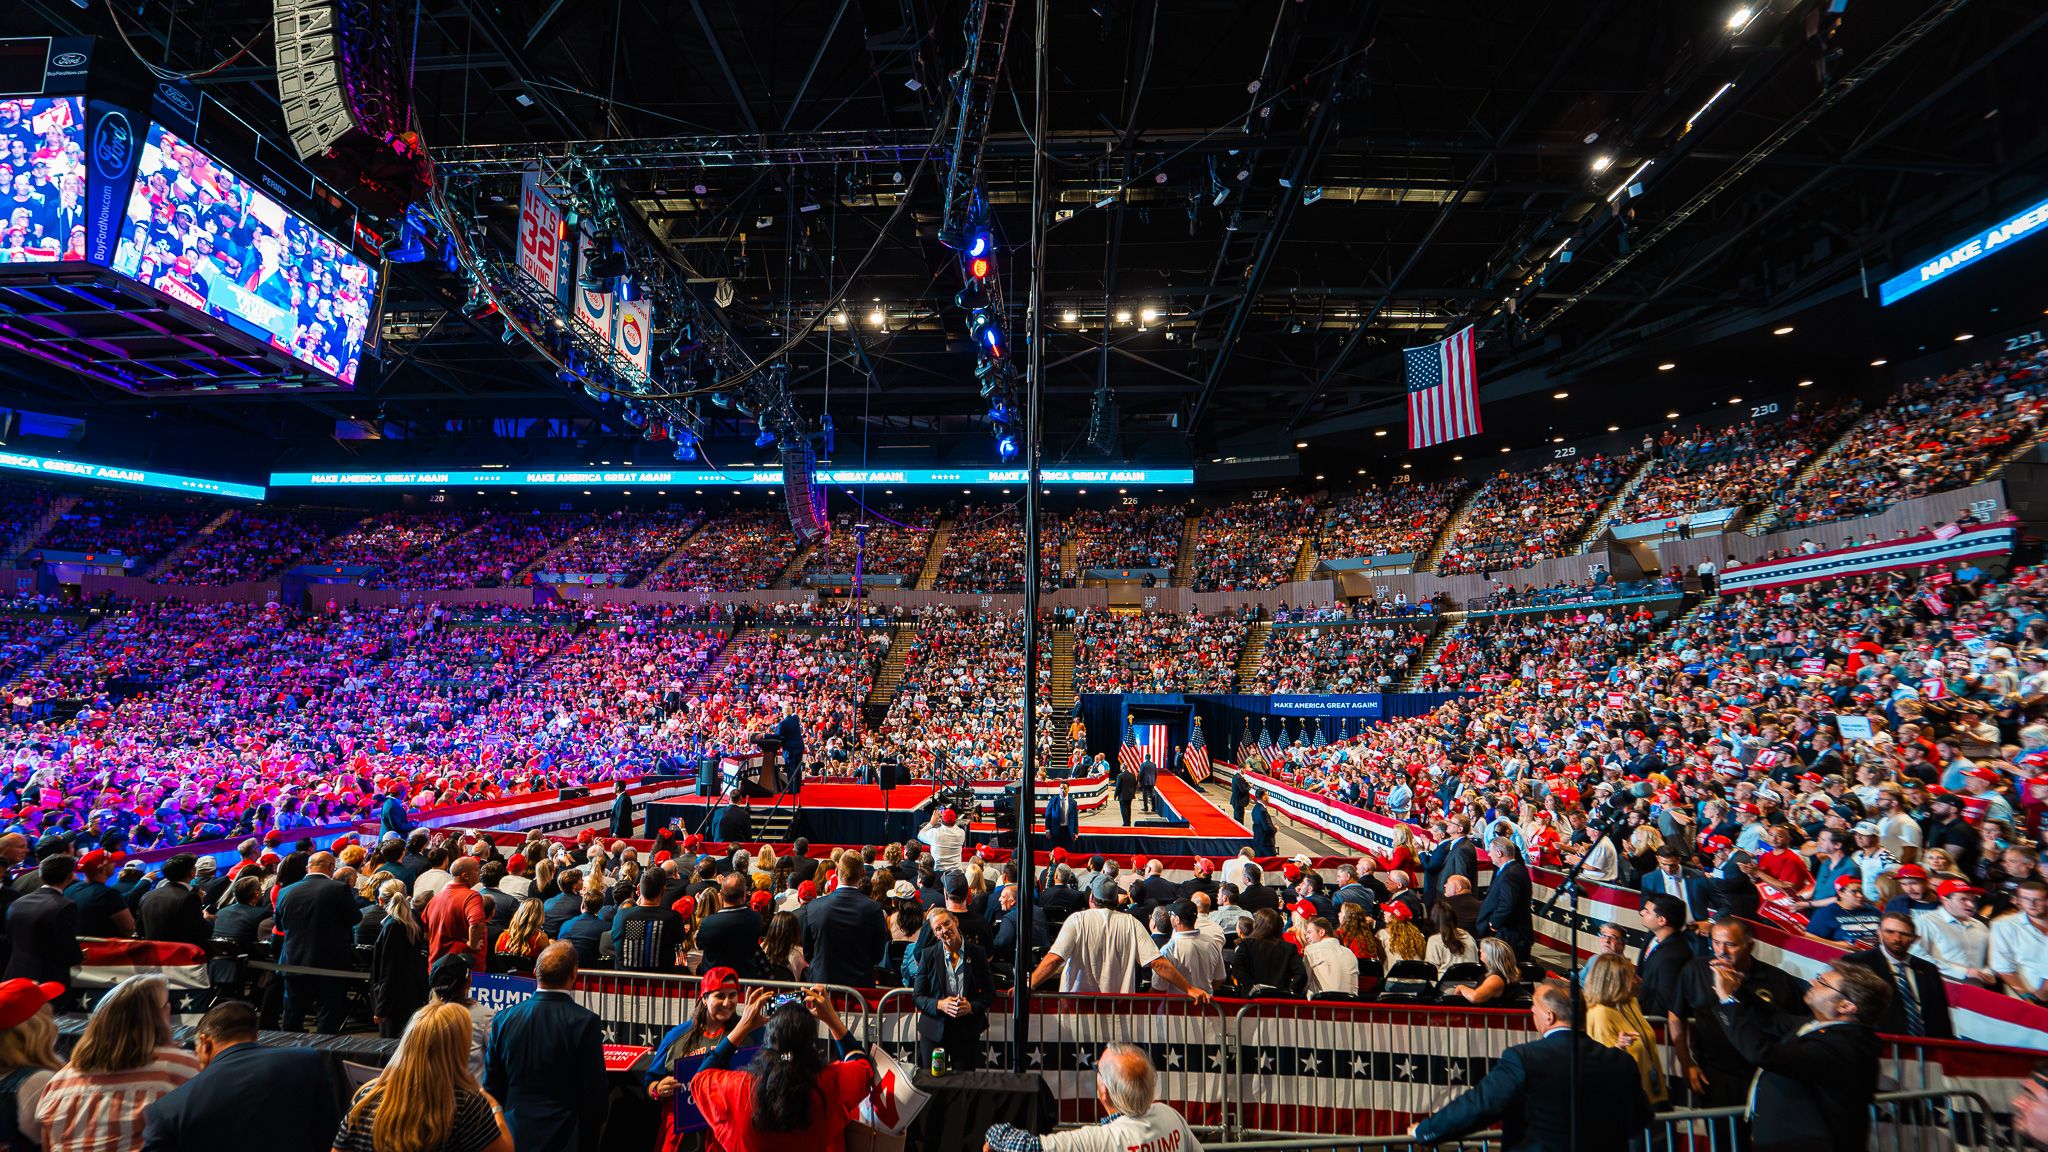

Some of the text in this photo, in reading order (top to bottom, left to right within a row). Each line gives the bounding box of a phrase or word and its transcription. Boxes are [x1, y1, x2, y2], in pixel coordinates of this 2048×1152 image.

[58, 54, 81, 65] Ford
[47, 69, 88, 77] BuyFordNow.com
[165, 86, 188, 108] Ford
[99, 121, 127, 169] Ford
[262, 174, 287, 197] PERIOD
[525, 185, 556, 234] NETS
[94, 185, 112, 261] BuyFordNow.com
[357, 228, 379, 250] TCL
[521, 209, 555, 273] 32
[1920, 239, 1982, 281] MAKE
[524, 253, 549, 289] ERVING
[2004, 330, 2045, 352] 231
[1751, 402, 1779, 418] 230
[1554, 446, 1576, 459] 229
[43, 460, 95, 475] GREAT
[97, 468, 145, 482] AGAIN
[527, 473, 671, 482] MAKE AMERICA GREAT AGAIN
[753, 473, 783, 482] MAKE
[833, 473, 868, 482] GREAT
[869, 472, 903, 482] AGAIN
[989, 472, 1019, 481] MAKE
[1072, 472, 1108, 481] GREAT
[1110, 472, 1145, 481] AGAIN
[311, 474, 448, 483] MAKE AMERICA GREAT AGAIN
[1392, 475, 1411, 484] 228
[429, 495, 444, 503] 220
[1252, 490, 1268, 499] 227
[1969, 499, 1997, 512] 123
[1375, 585, 1389, 593] 121
[1352, 701, 1378, 709] AGAIN!
